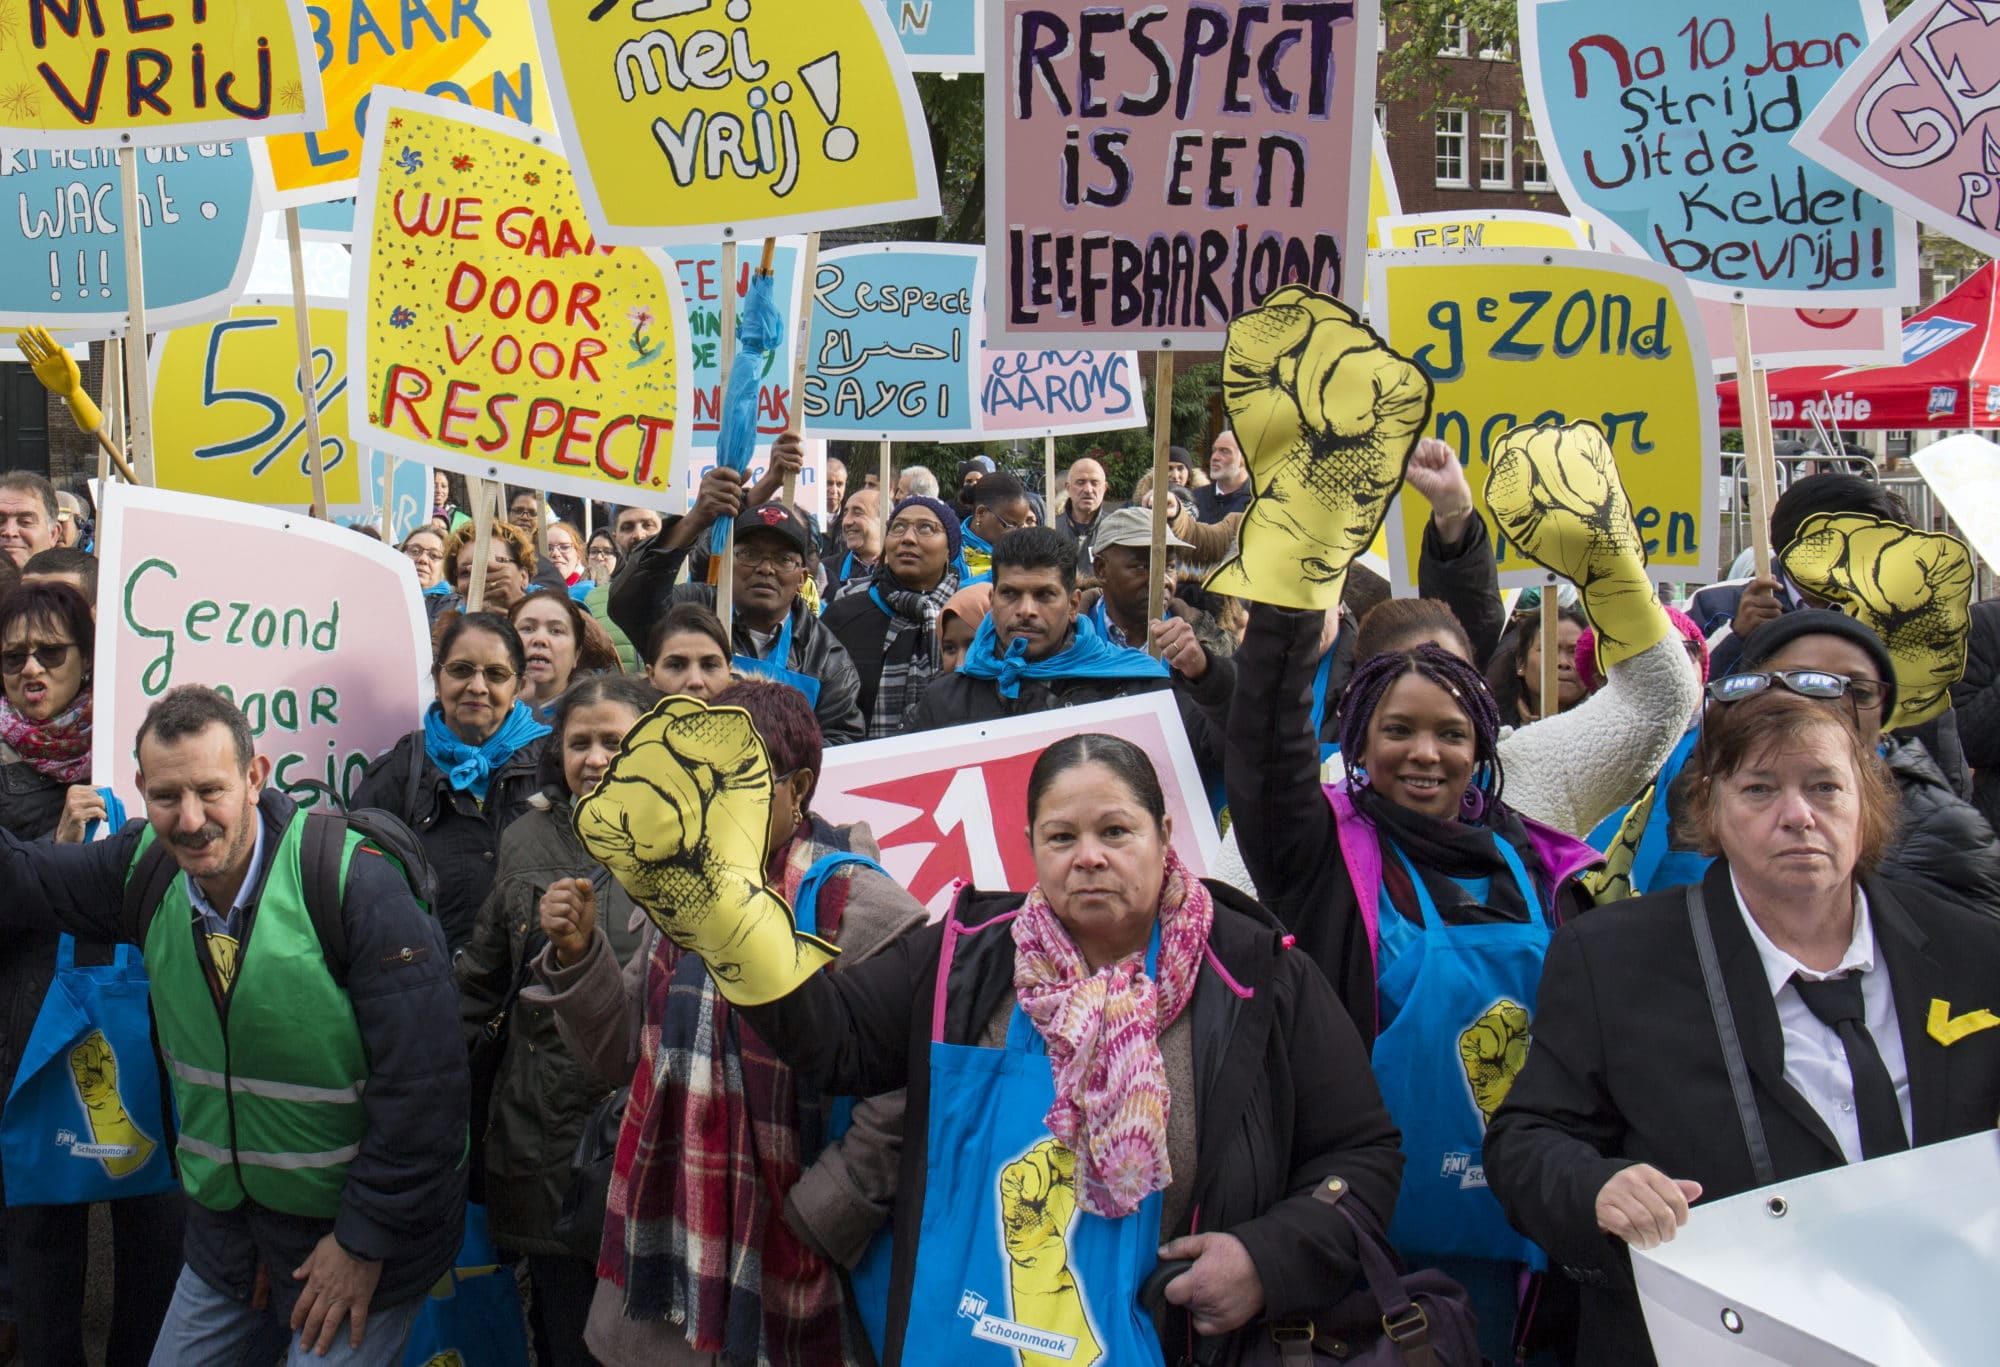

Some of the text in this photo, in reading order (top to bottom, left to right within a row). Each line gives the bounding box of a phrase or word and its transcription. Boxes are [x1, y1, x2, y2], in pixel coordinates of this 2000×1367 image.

[1013, 0, 1354, 121] RESPECT
[1678, 16, 1736, 71] 10
[394, 188, 483, 240] WE
[445, 260, 602, 332] DOOR
[813, 263, 972, 319] Respect
[444, 324, 608, 384] VOOR
[194, 318, 348, 477] 5%
[1769, 391, 1872, 422] in actie
[1930, 389, 1956, 410] FNV
[123, 557, 340, 697] Gezond
[1441, 1155, 1470, 1173] FNV
[958, 1294, 987, 1319] FNV
[982, 1319, 1068, 1354] Schoonmaak
